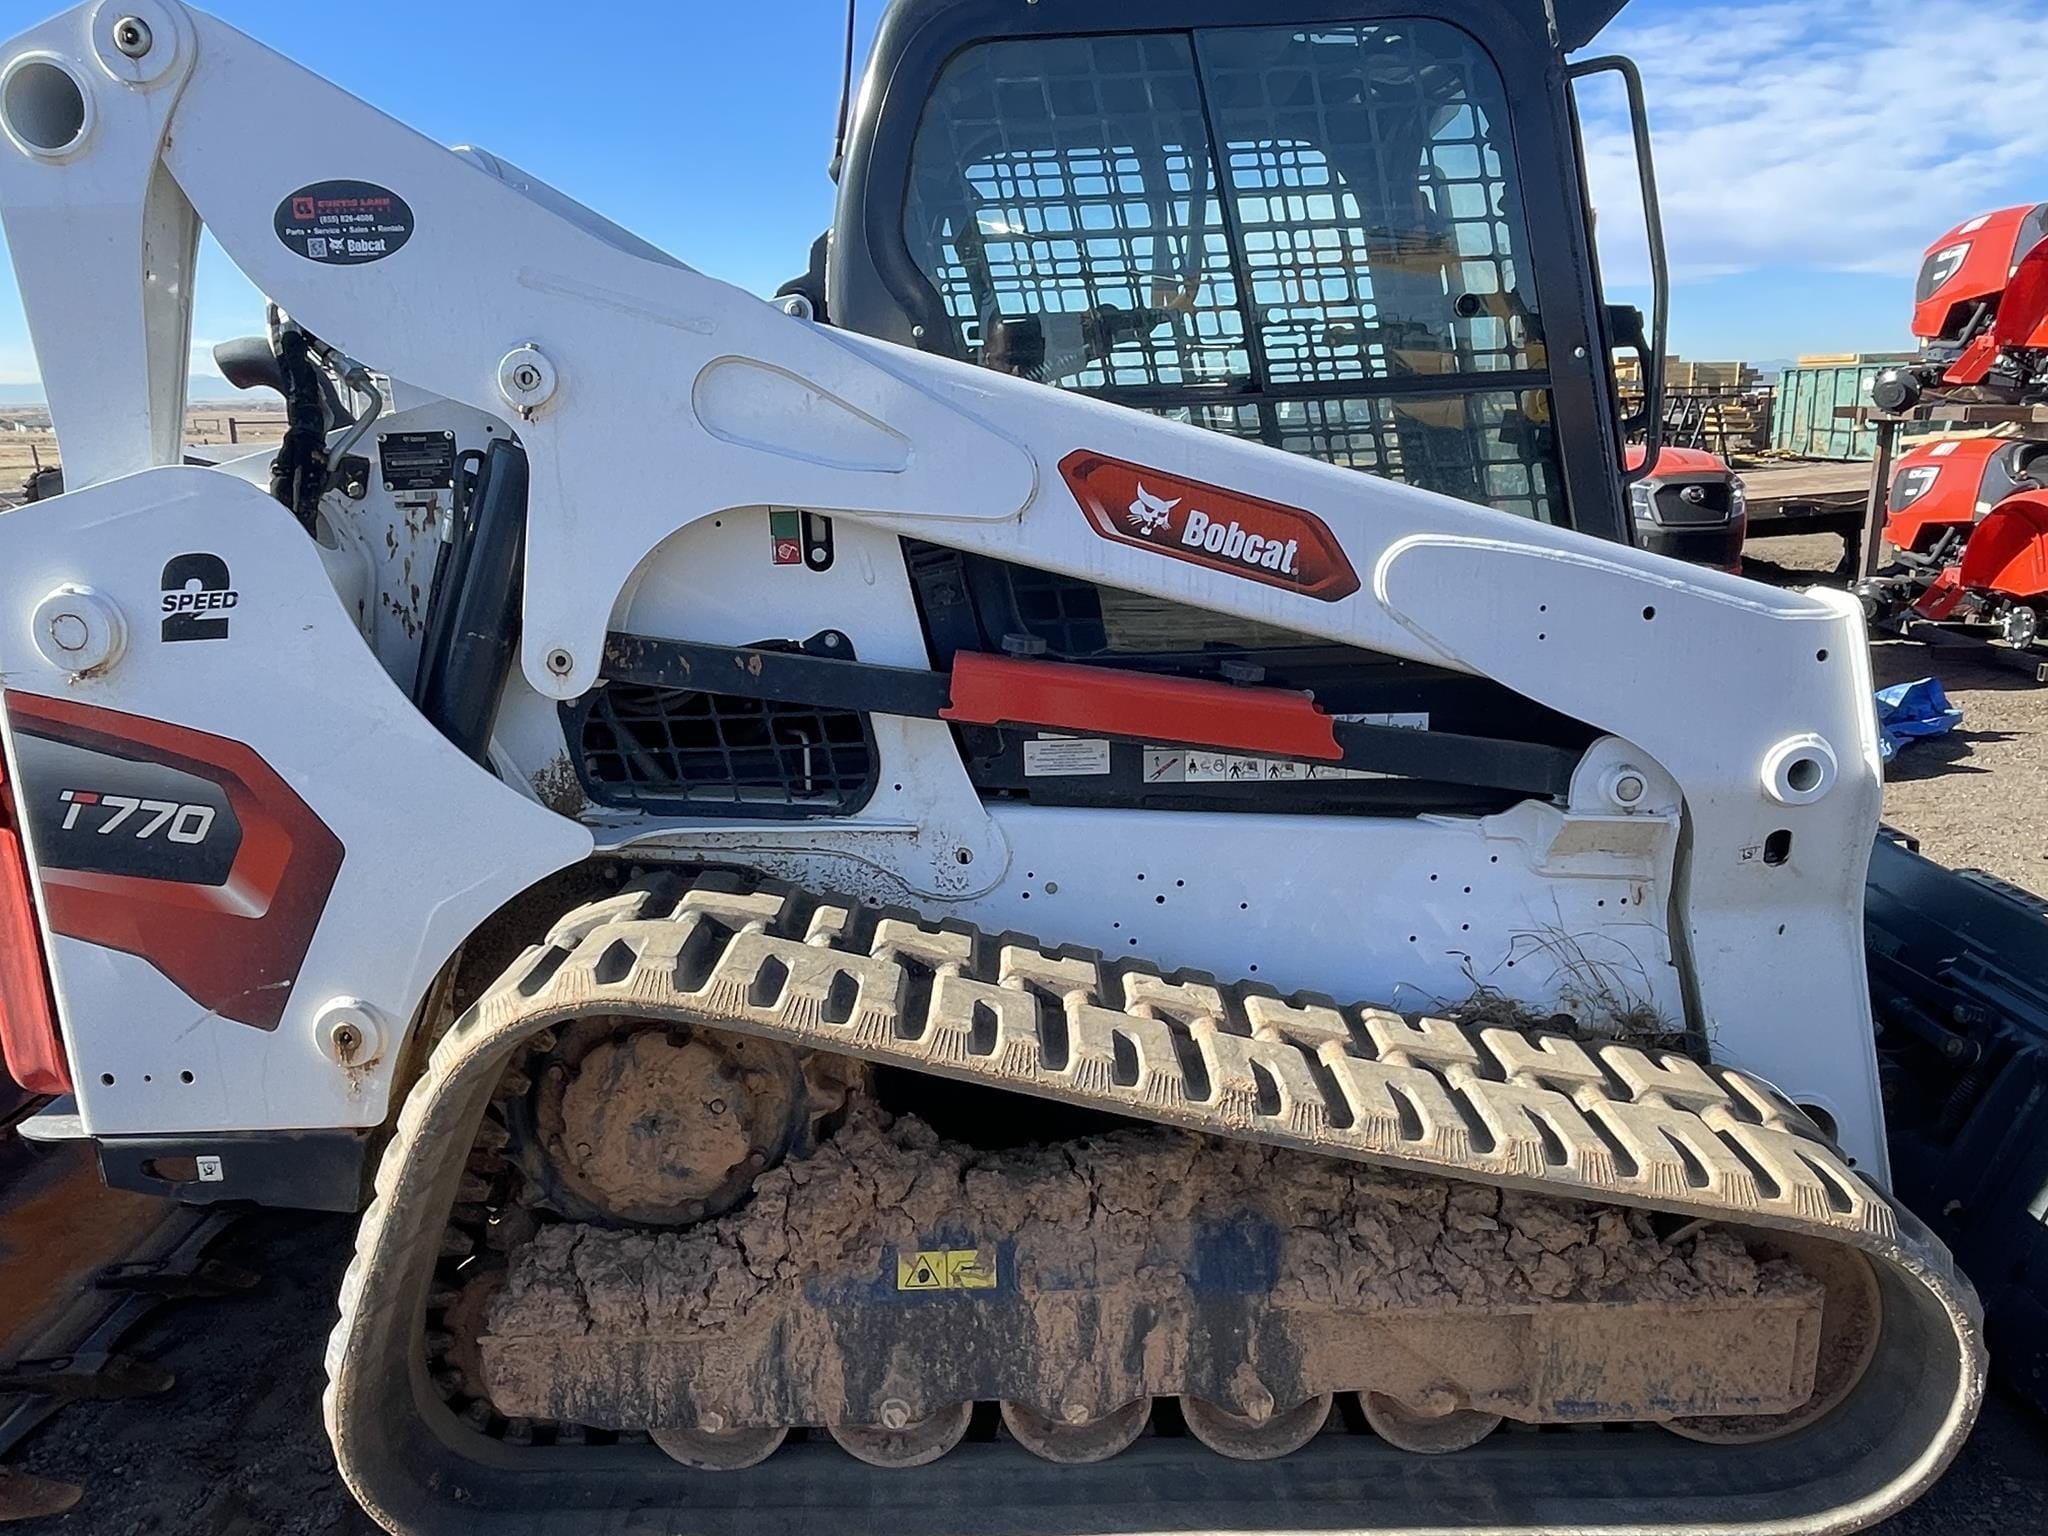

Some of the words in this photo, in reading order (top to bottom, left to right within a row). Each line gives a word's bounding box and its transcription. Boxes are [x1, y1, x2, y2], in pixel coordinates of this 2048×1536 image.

[286, 228, 305, 236] Parts
[313, 227, 340, 235] Service
[378, 225, 405, 233] Rentals
[347, 239, 387, 252] Bobcat
[1181, 509, 1299, 574] Bobcat
[161, 552, 230, 642] 2
[161, 591, 239, 612] SPEED
[60, 790, 217, 844] T770
